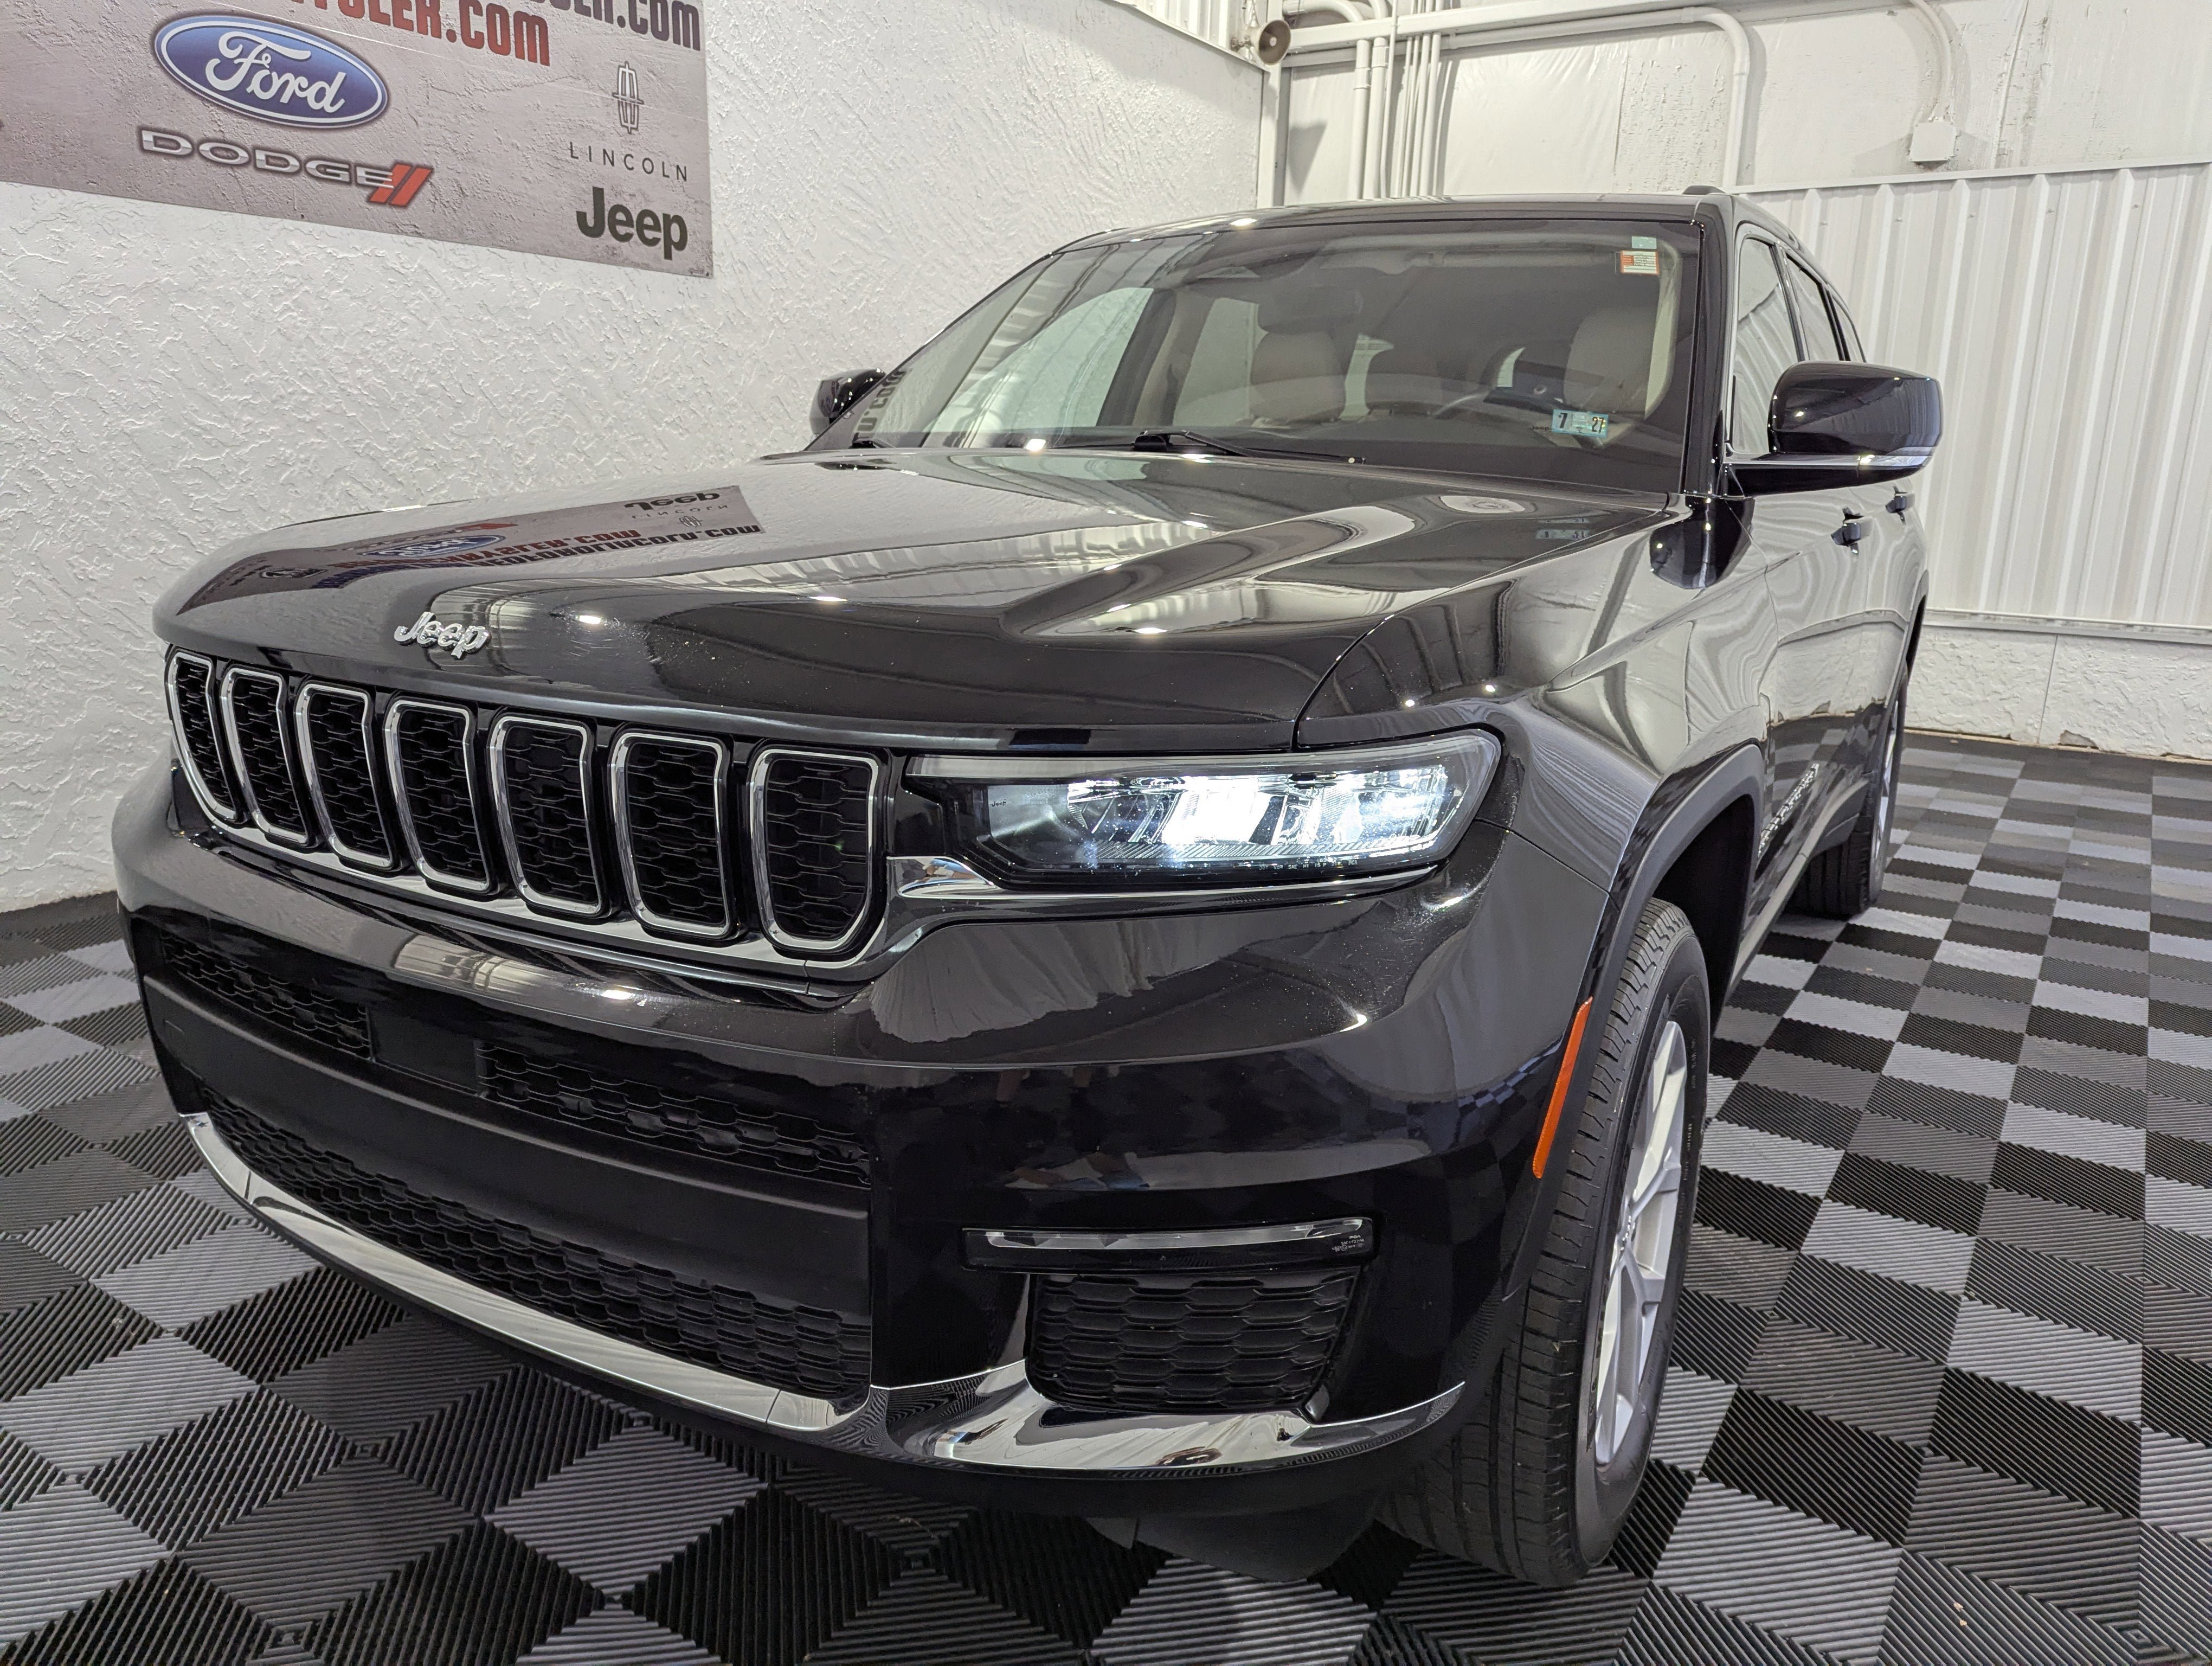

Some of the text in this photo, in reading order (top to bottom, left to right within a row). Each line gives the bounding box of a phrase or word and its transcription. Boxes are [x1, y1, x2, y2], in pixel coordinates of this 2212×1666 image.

[205, 31, 346, 113] Ford
[142, 130, 395, 189] DODGE
[569, 142, 688, 181] LINCOLN
[576, 187, 688, 260] Jeep
[1558, 412, 1568, 428] 7
[1591, 416, 1605, 433] 27
[394, 611, 492, 660] Jeep
